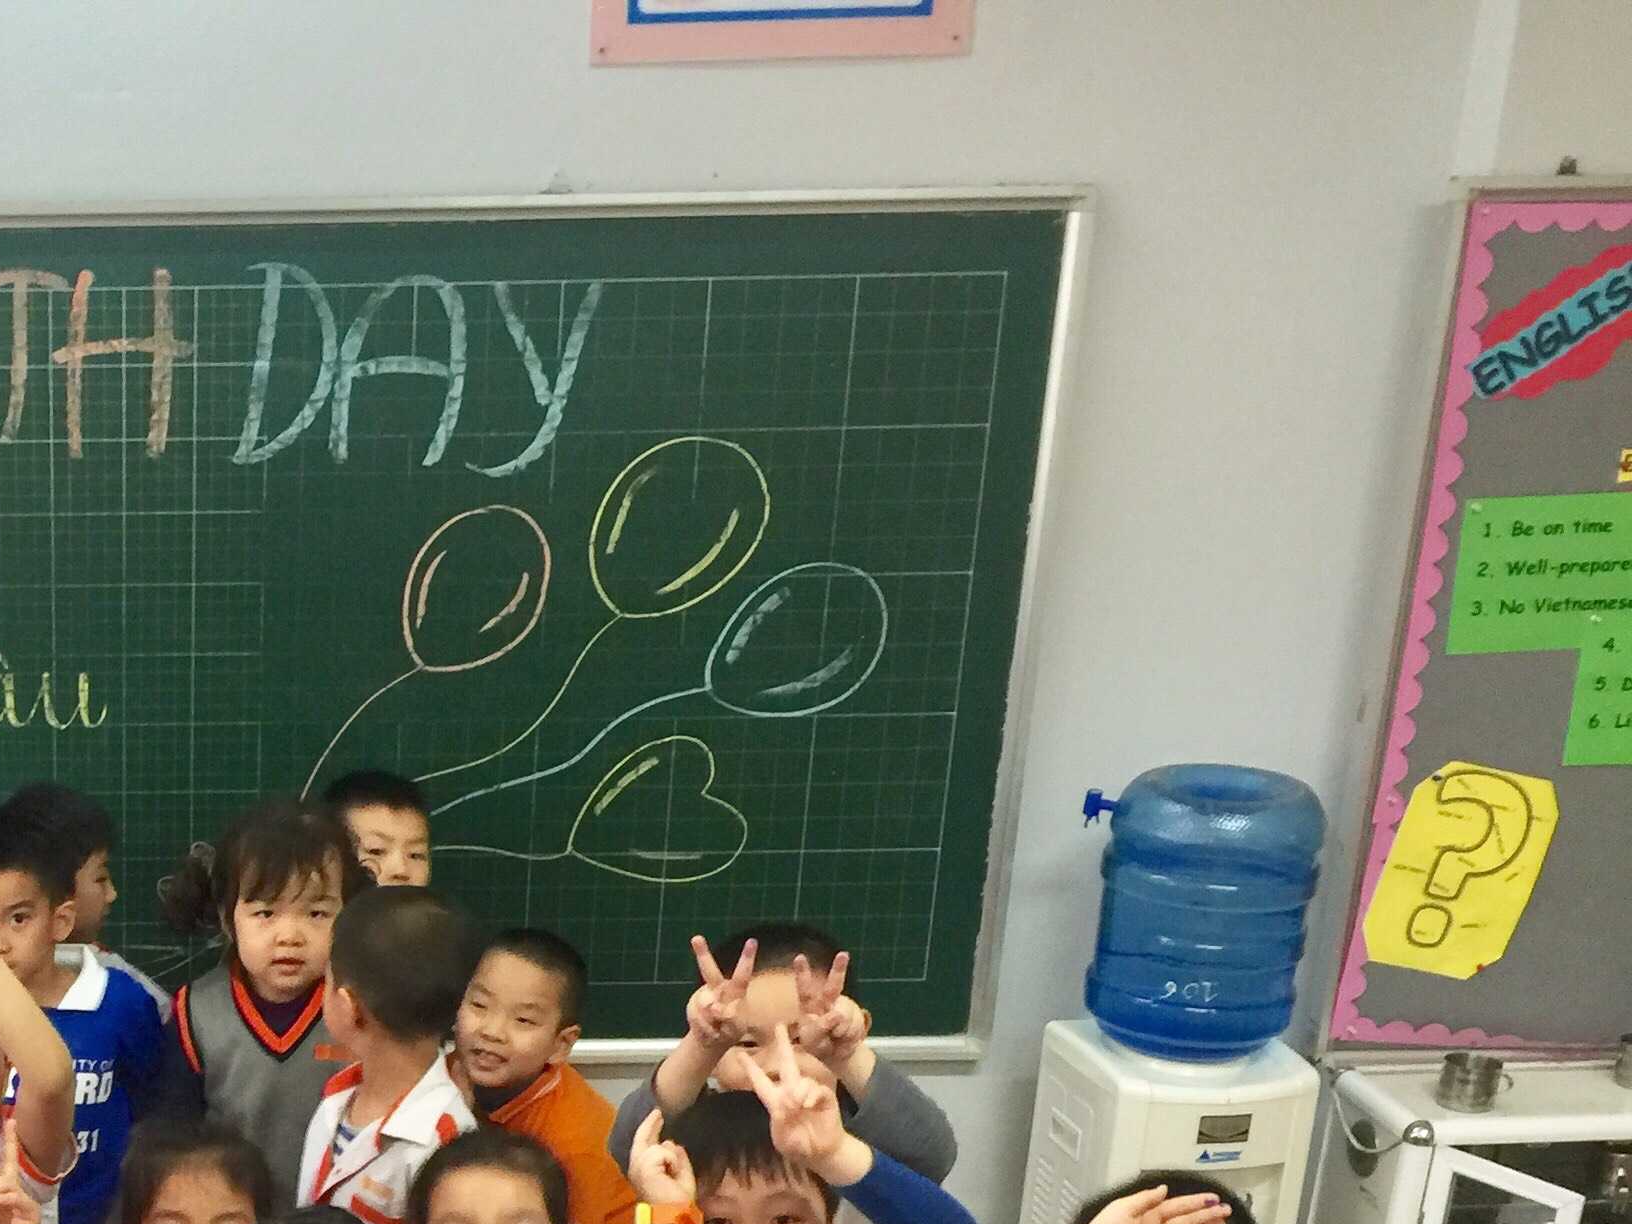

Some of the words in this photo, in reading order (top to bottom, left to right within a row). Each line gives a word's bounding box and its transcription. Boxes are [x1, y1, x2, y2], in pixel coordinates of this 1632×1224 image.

[1472, 264, 1632, 395] ENGLIS
[232, 261, 603, 478] DAY
[1511, 520, 1534, 537] Be
[1543, 522, 1564, 536] on
[1573, 520, 1613, 534] time
[1507, 558, 1632, 579] Well-prepare
[1499, 599, 1526, 615] No
[74, 1070, 114, 1105] RD
